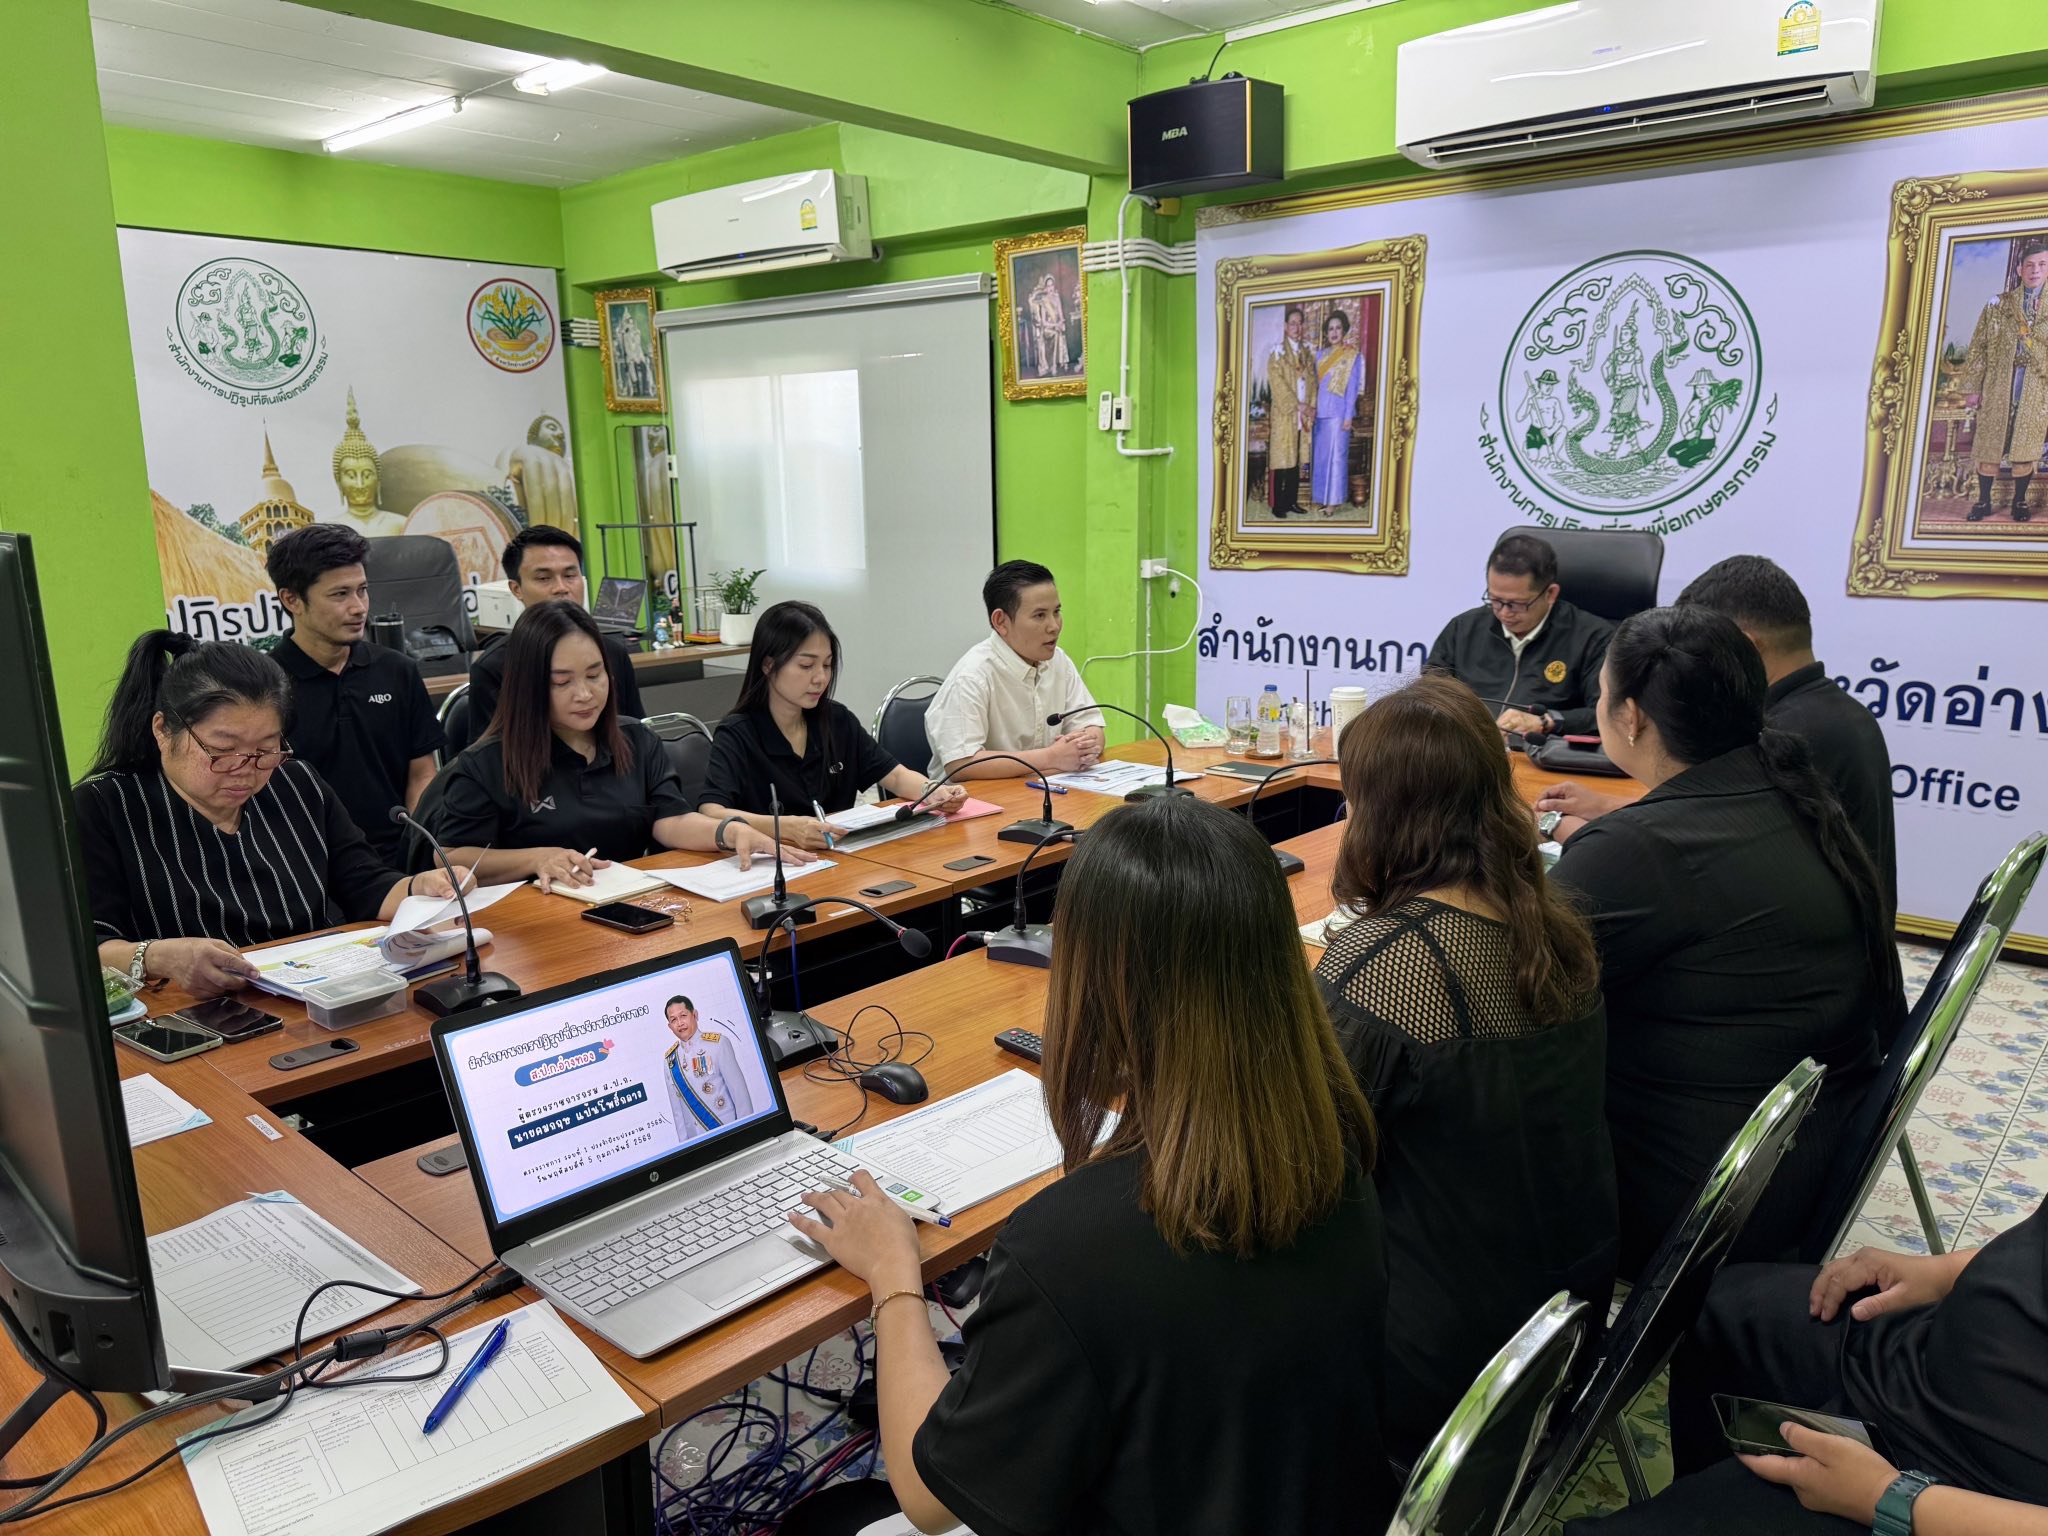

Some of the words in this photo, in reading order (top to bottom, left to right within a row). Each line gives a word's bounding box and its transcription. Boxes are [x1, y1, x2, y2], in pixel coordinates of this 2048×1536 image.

[1161, 126, 1188, 141] MBA
[168, 343, 329, 407] สำนักงานการปฏิรูปที่ดินเพื่อเกษตรกรรม
[1891, 764, 2021, 812] Office
[468, 1005, 650, 1070] สำนักงานการปฏิรูปที่ดินจังหวัดอ่างทอง
[530, 1050, 596, 1081] ส.ป.ก.อ่างทอง
[603, 1077, 632, 1091] ส.ป.ก.
[633, 1133, 652, 1146] 2569
